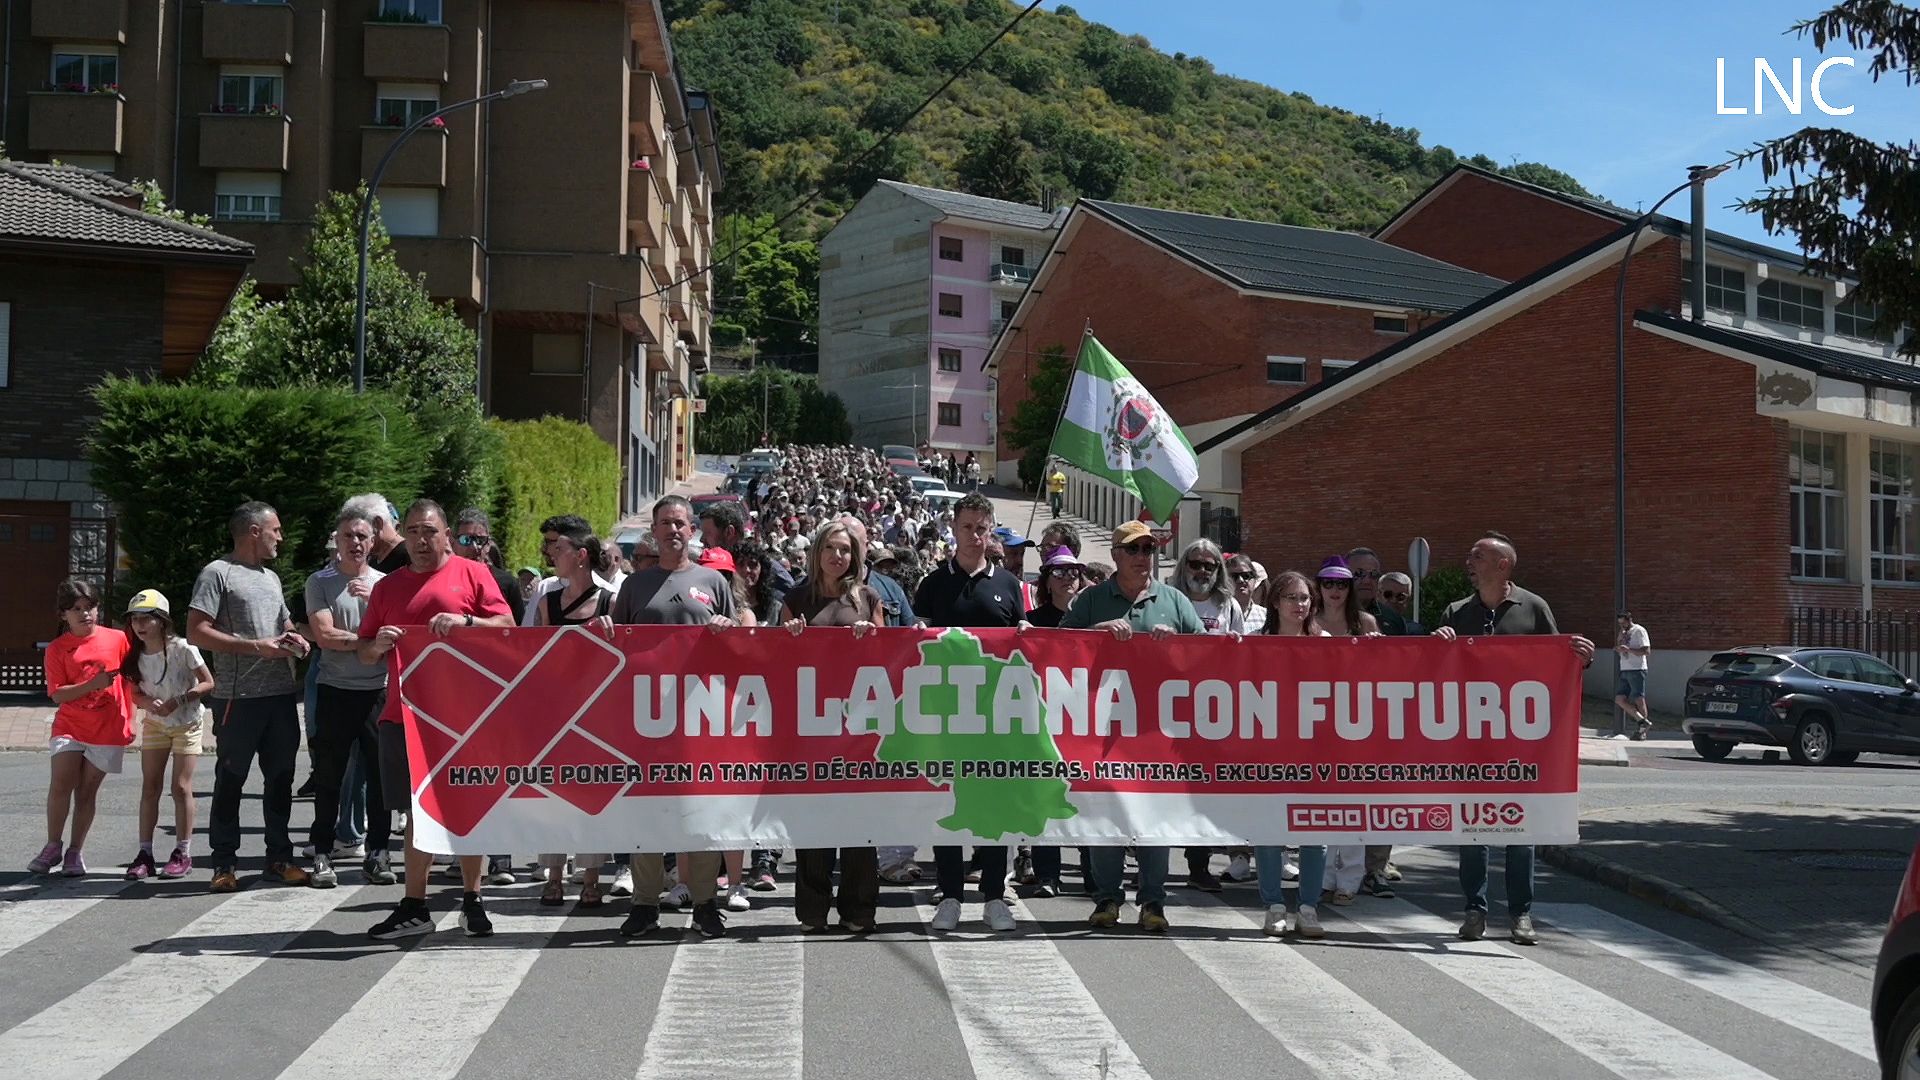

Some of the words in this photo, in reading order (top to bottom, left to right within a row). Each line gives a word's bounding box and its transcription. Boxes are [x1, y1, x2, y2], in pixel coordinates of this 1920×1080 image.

[632, 674, 773, 739] UNA
[797, 665, 1139, 738] LACIANA
[1157, 679, 1278, 741] CON
[1297, 679, 1551, 742] FUTURO
[448, 765, 500, 787] HAY
[505, 764, 554, 788] QUE
[559, 762, 643, 786] PONER
[648, 761, 695, 784] FIN
[697, 761, 716, 784] A
[717, 760, 809, 783] TANTAS
[812, 756, 921, 781] DÉCADAS
[925, 759, 956, 780] DE
[960, 759, 1091, 782] PROMESAS,
[1094, 760, 1210, 783] MENTIRAS,
[1214, 762, 1315, 783] EXCUSAS
[1316, 762, 1331, 783] Y
[1335, 758, 1539, 783] DISCRIMINACIÓN
[1292, 808, 1362, 827] CCOO
[1372, 807, 1424, 829] UGT
[1460, 802, 1525, 826] USO
